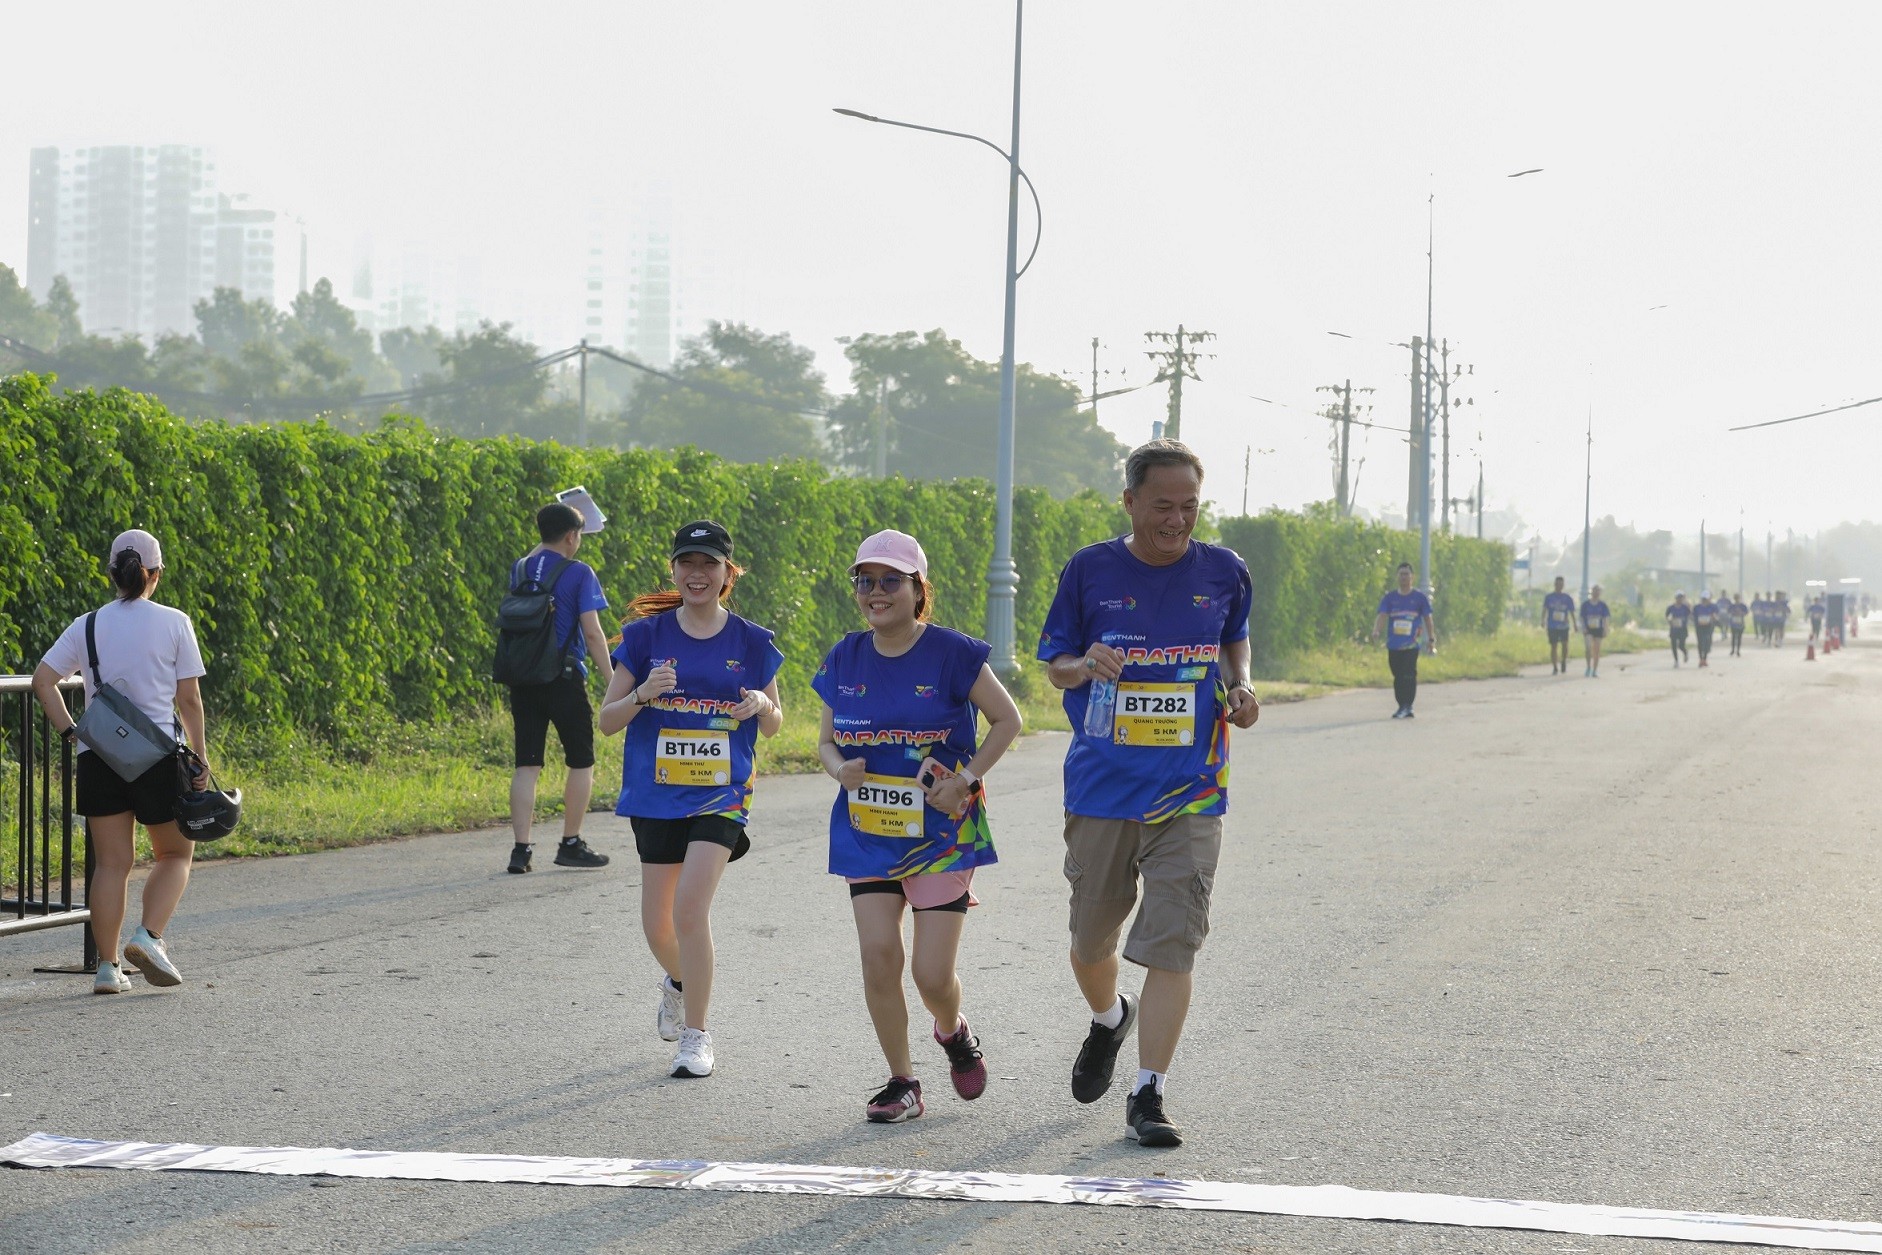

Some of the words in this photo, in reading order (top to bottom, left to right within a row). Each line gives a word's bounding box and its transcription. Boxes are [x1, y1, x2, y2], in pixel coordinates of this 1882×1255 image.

[1125, 696, 1187, 713] BT282
[665, 741, 721, 757] BT146
[857, 786, 913, 806] BT196
[888, 819, 904, 827] KM
